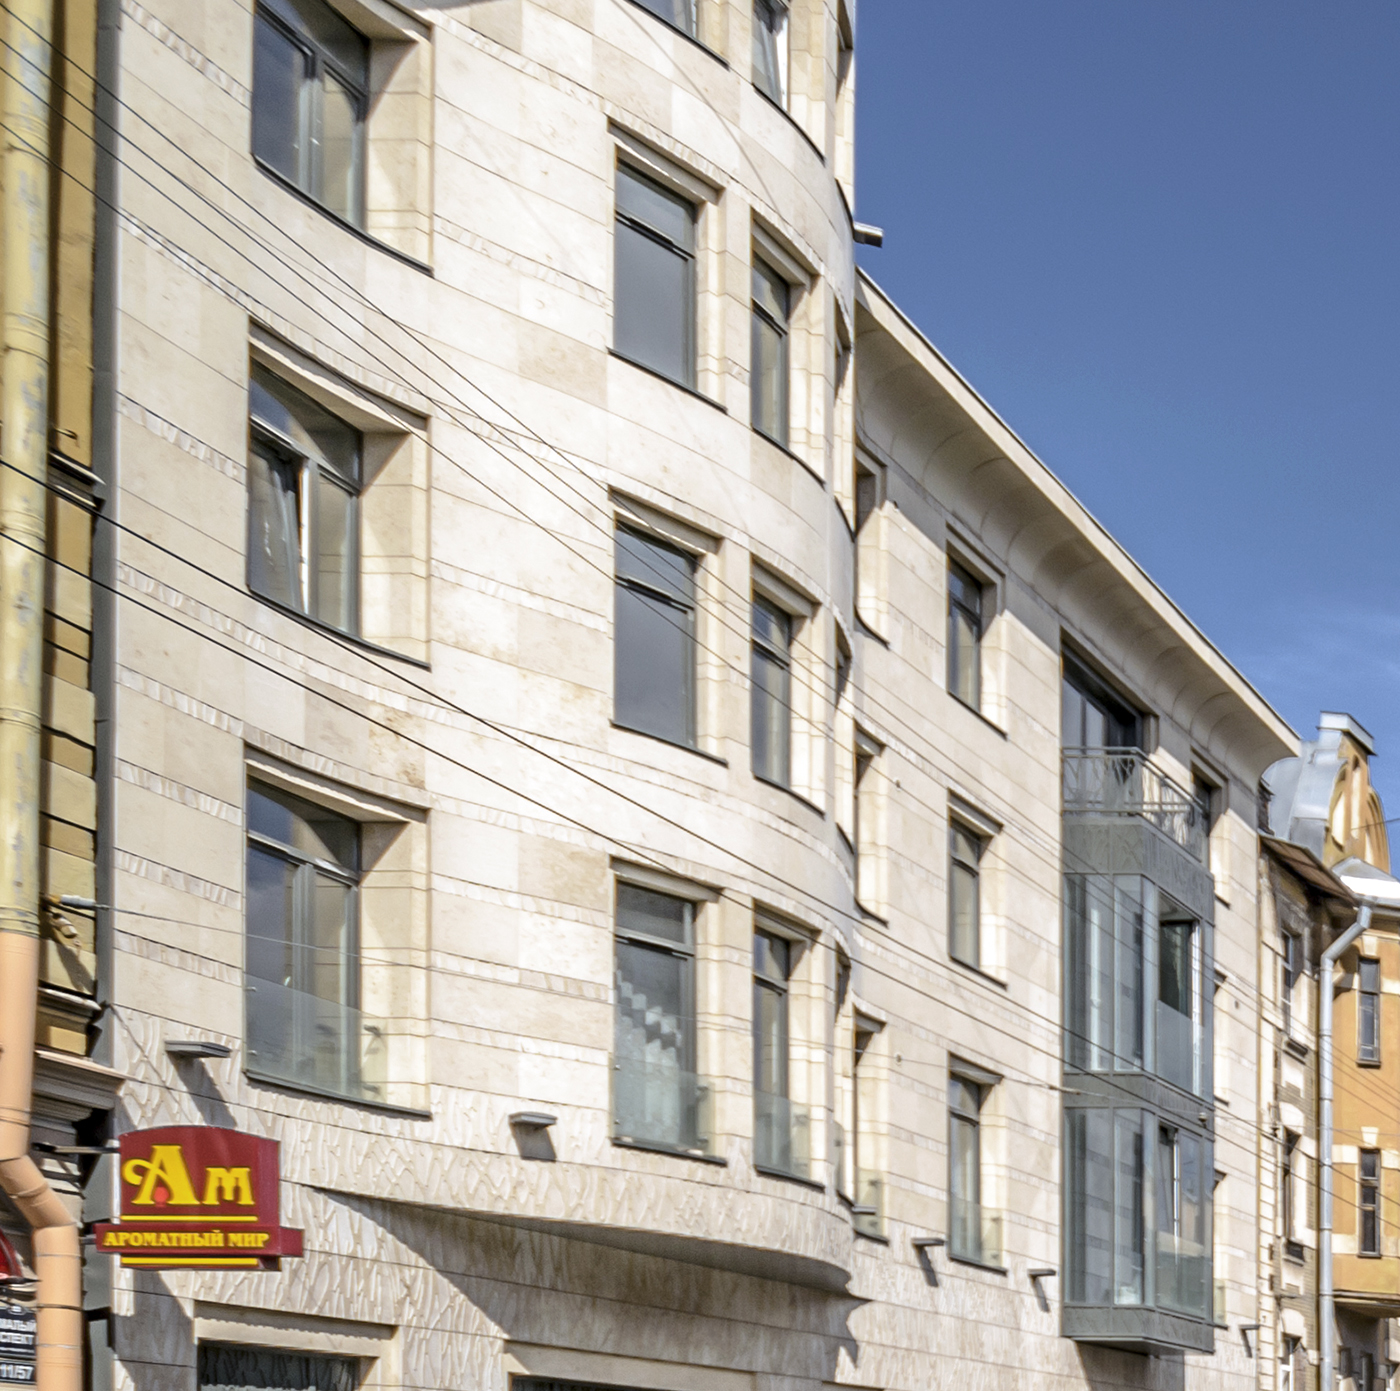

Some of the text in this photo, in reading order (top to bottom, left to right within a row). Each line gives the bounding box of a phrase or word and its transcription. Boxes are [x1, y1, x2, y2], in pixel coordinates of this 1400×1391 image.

[122, 1145, 256, 1206] Ам
[103, 1230, 270, 1248] АРОМАТНЫЙ МИР
